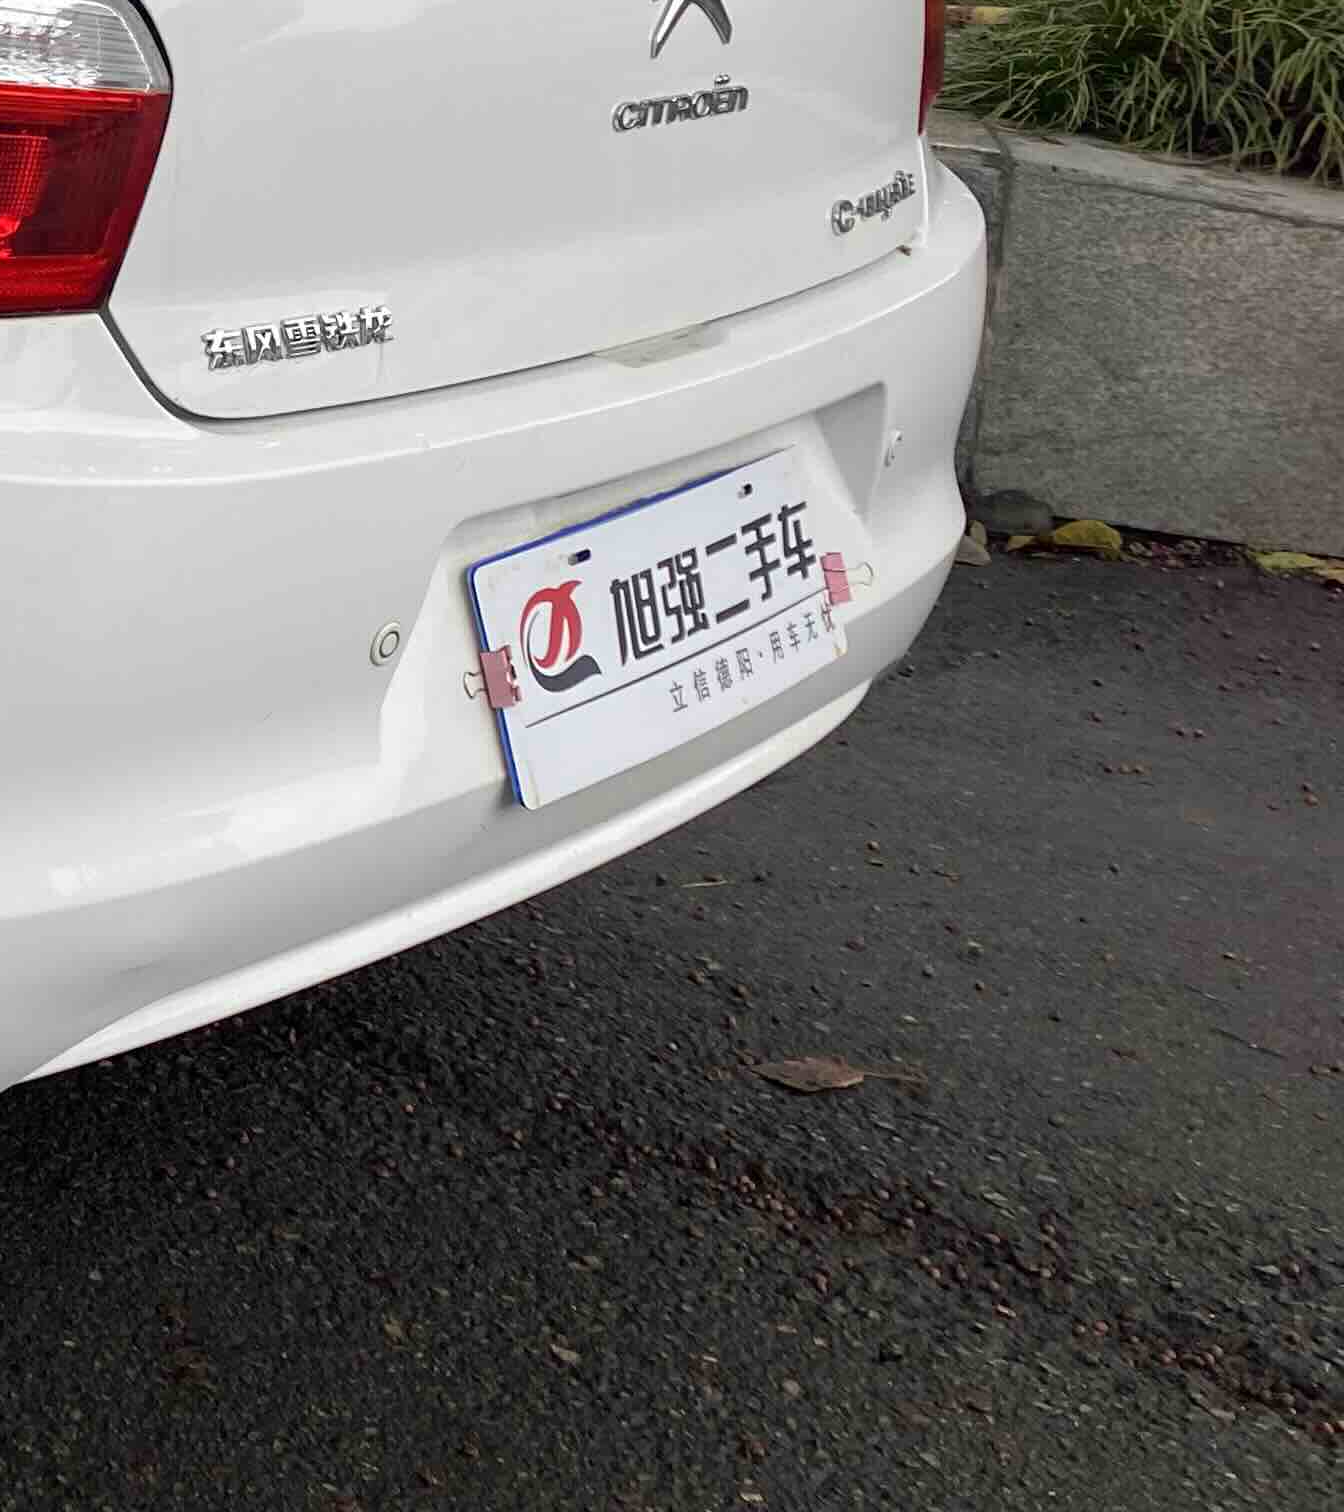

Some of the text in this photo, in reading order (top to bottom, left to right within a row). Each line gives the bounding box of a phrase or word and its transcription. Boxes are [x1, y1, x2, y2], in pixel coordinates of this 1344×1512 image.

[200, 303, 394, 370] 东风雪铁龙
[609, 501, 817, 667] 旭强二手车
